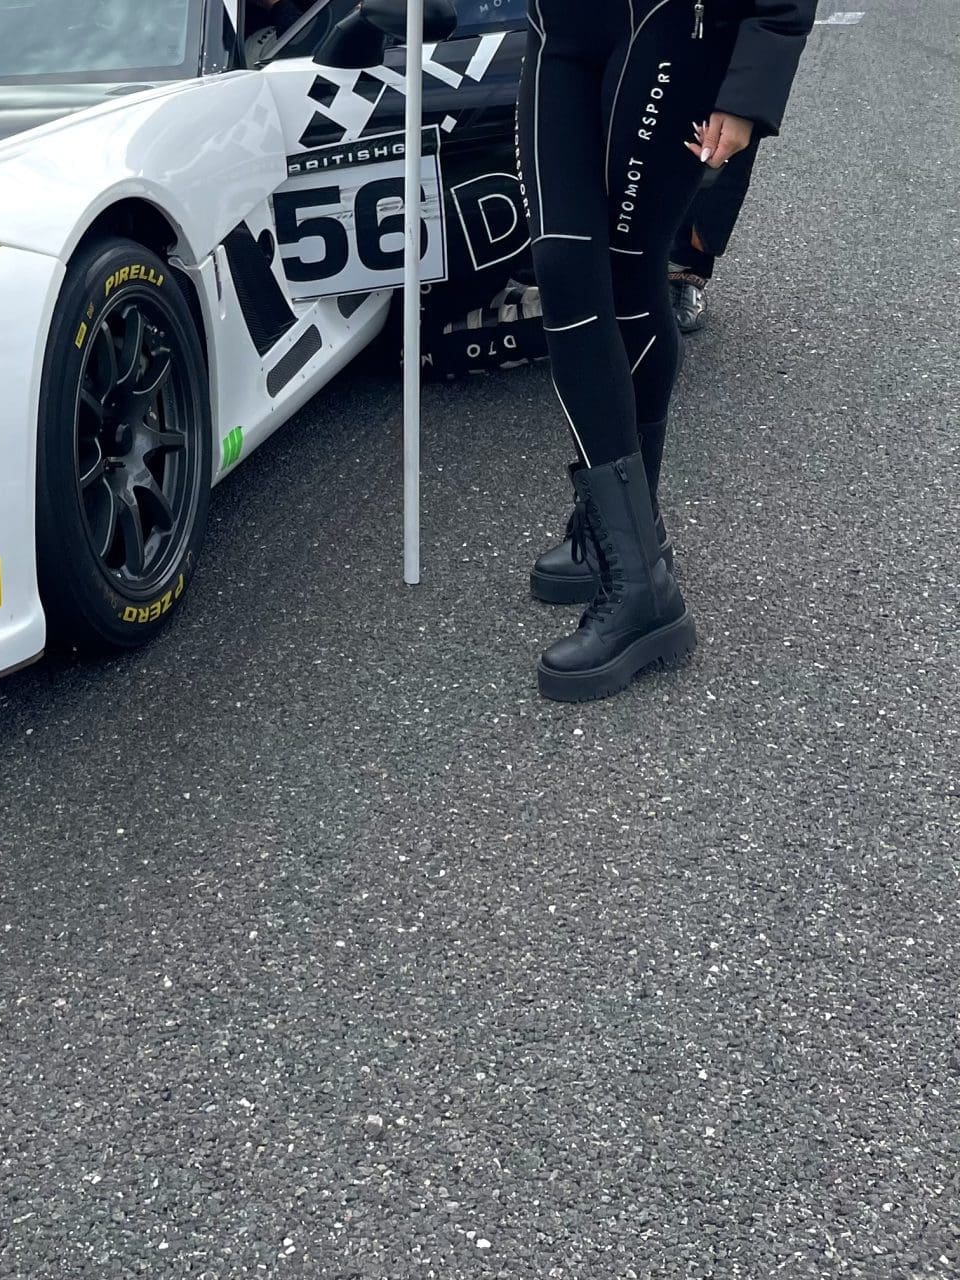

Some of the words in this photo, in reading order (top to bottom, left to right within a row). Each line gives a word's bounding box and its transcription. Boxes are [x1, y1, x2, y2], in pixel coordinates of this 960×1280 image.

[288, 143, 406, 172] BRITISHG
[272, 176, 429, 283] 56
[450, 172, 532, 271] D
[104, 264, 164, 297] PIRELLI
[466, 334, 517, 358] DTO
[122, 590, 173, 623] ZERO
